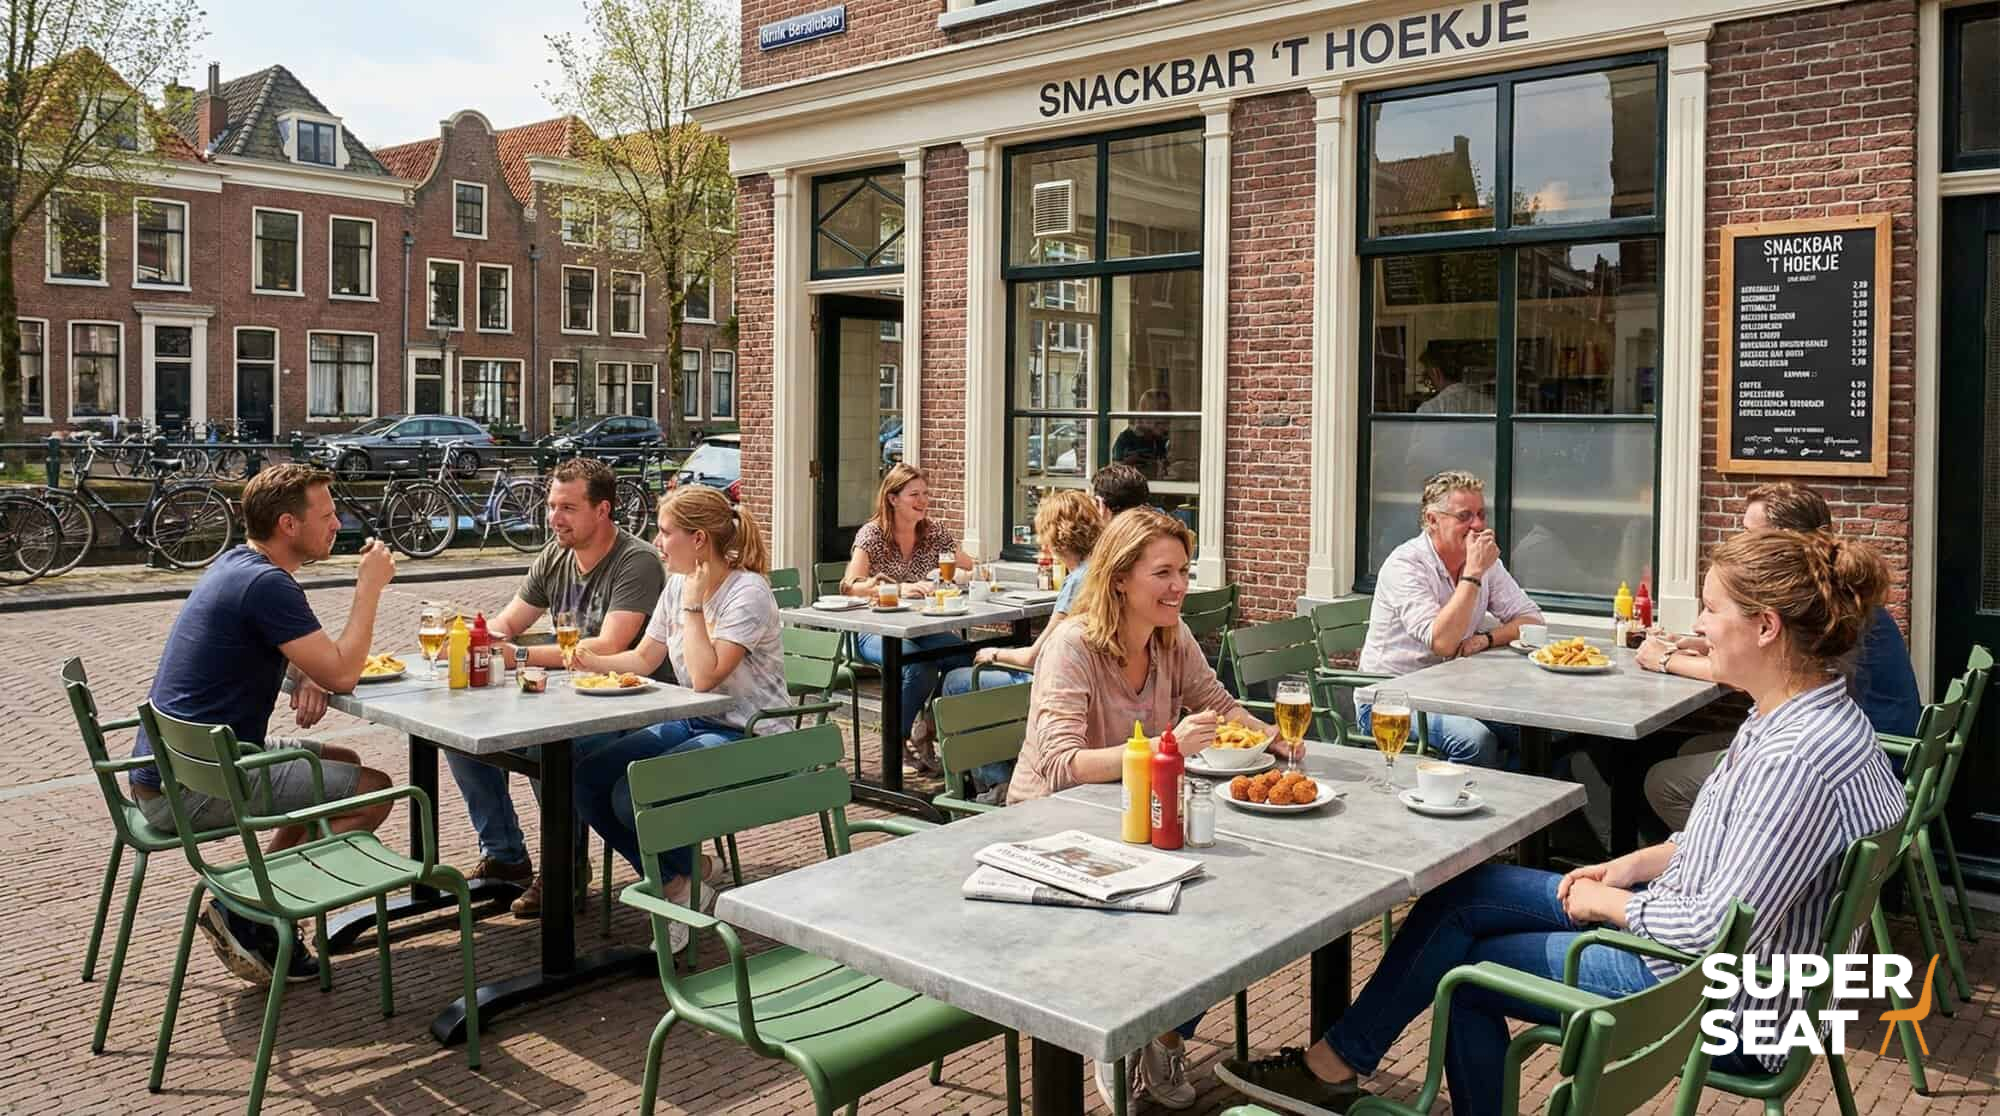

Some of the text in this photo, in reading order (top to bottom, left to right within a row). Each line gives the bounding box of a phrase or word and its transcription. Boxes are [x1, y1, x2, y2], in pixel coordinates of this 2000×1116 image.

[1039, 48, 1255, 117] SNACKBAR
[1326, 0, 1529, 71] HOEKJE
[1763, 235, 1843, 256] SNACKBAR
[1783, 254, 1840, 273] HOEKJE
